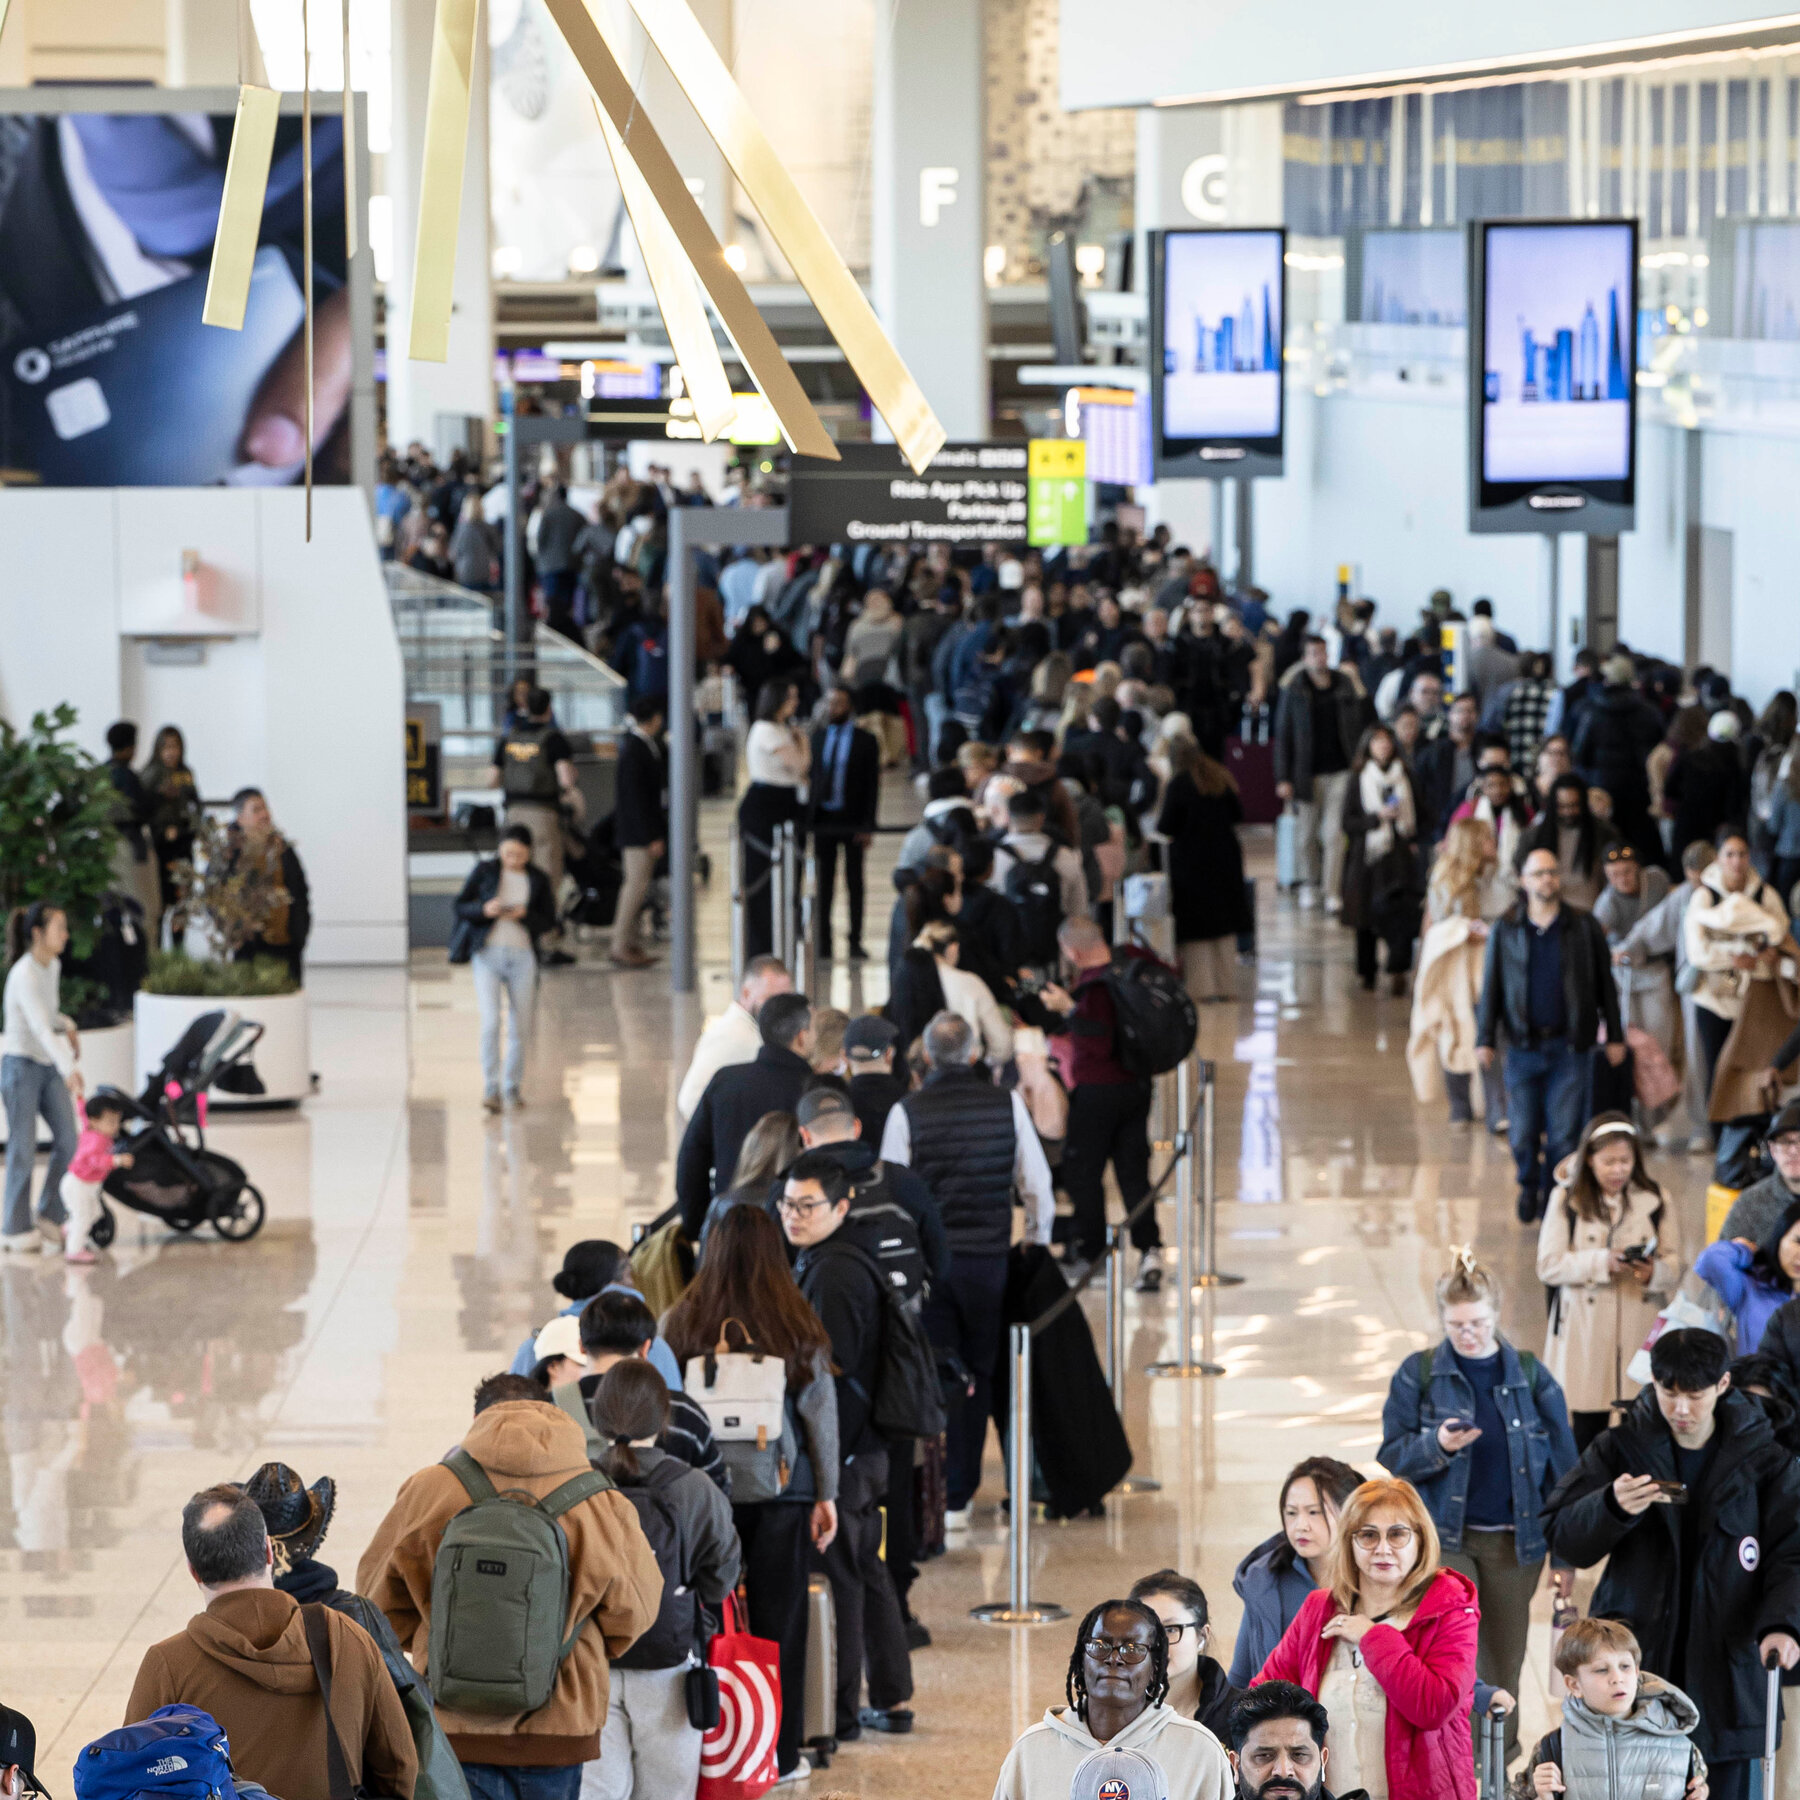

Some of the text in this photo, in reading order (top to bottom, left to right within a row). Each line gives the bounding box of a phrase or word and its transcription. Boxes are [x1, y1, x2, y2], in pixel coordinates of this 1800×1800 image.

[920, 167, 959, 226] F
[889, 480, 1026, 502] Ride App Pick Up
[947, 501, 1006, 523] Parking
[847, 520, 1026, 543] Ground Transportation
[480, 1562, 504, 1574] YETI
[1104, 1781, 1124, 1794] NY
